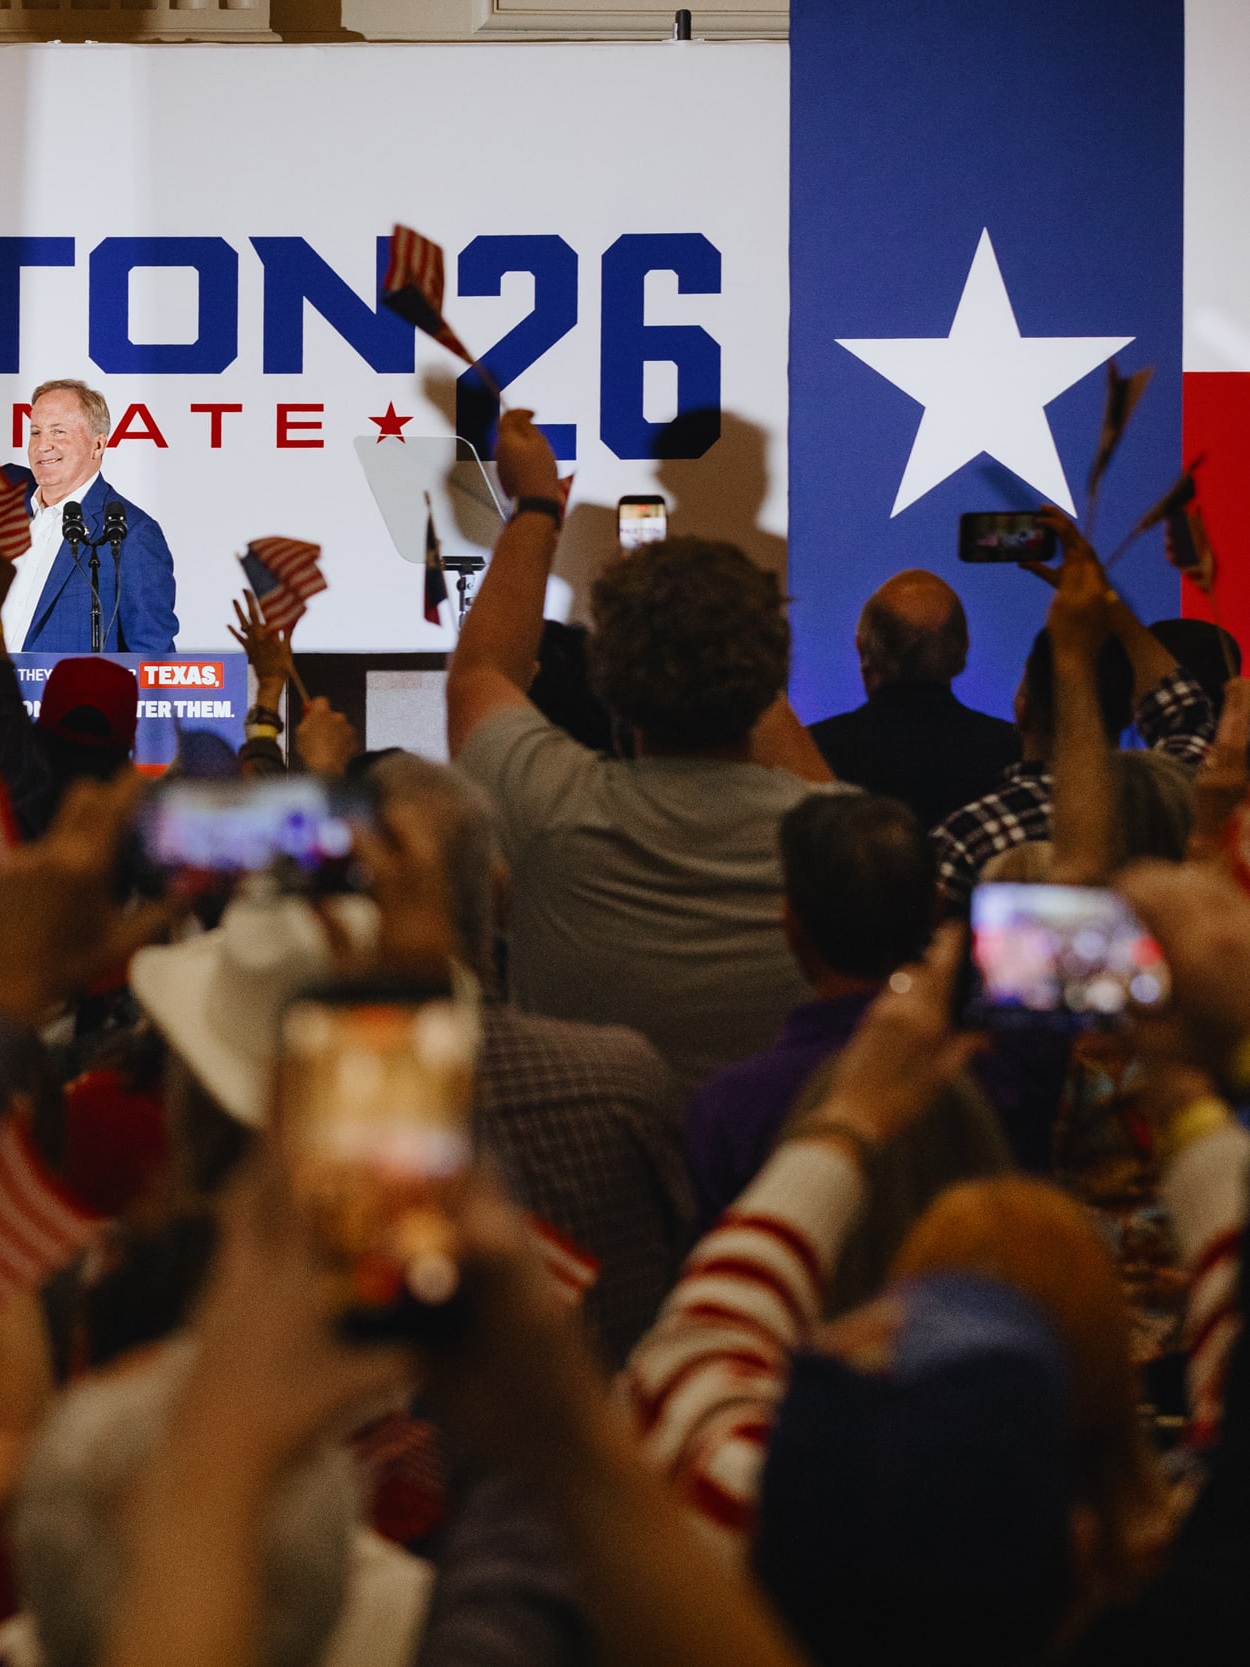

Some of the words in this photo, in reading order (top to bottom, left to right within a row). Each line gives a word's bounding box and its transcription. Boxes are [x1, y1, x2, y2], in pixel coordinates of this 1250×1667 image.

[455, 232, 722, 461] 26
[17, 668, 54, 682] THEY
[143, 665, 220, 688] TEXAS,
[136, 700, 172, 718] TER
[173, 700, 235, 718] THEM.
